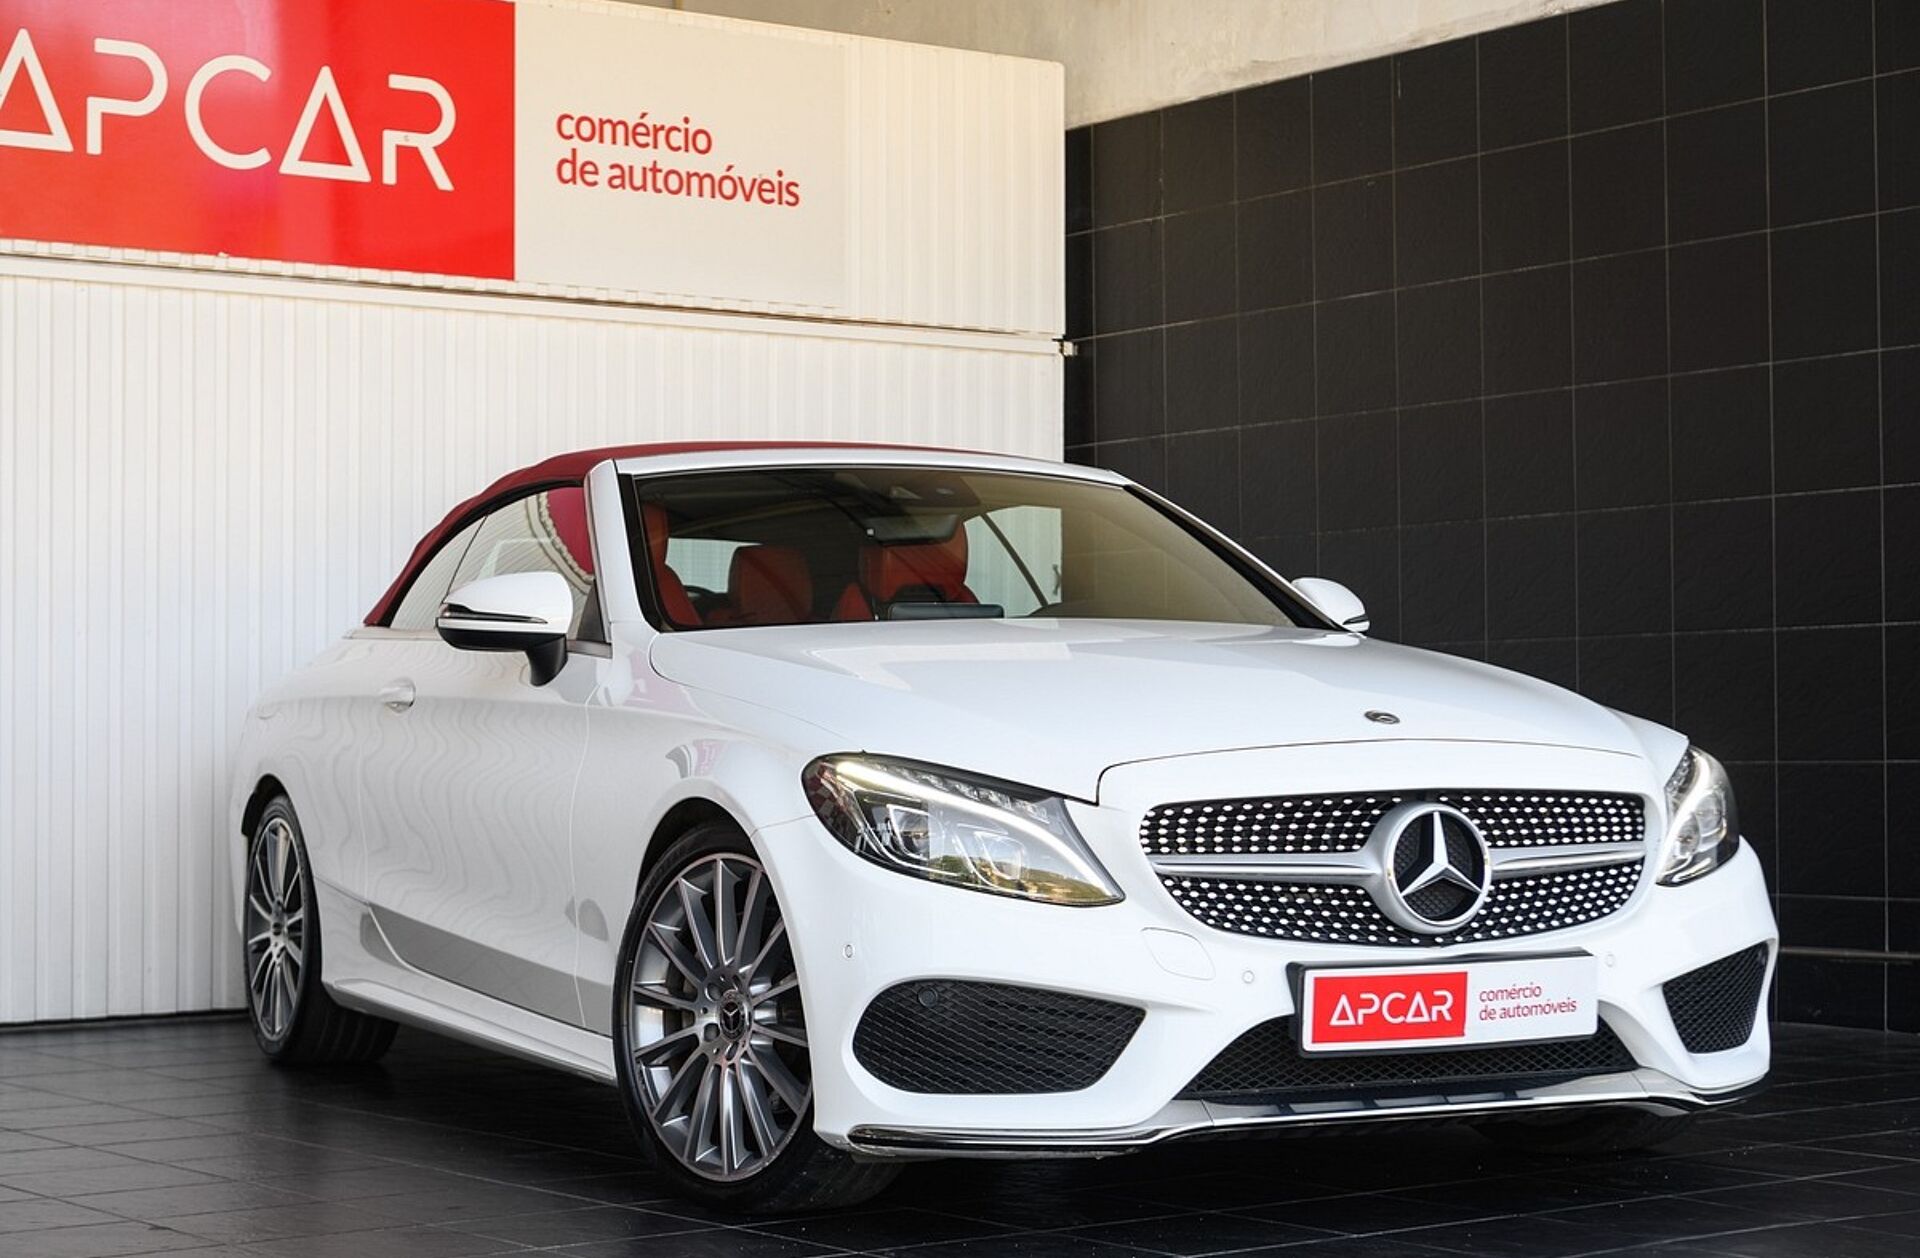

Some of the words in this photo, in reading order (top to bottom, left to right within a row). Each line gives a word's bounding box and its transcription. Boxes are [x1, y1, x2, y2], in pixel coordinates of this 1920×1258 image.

[0, 28, 456, 192] APCAR
[555, 112, 713, 155] comércio
[555, 147, 600, 188] de
[607, 160, 801, 208] automóveis
[1329, 990, 1453, 1026] APCAR
[1479, 982, 1542, 1003] comércio
[1479, 1004, 1496, 1021] de
[1499, 997, 1577, 1020] automóveis
